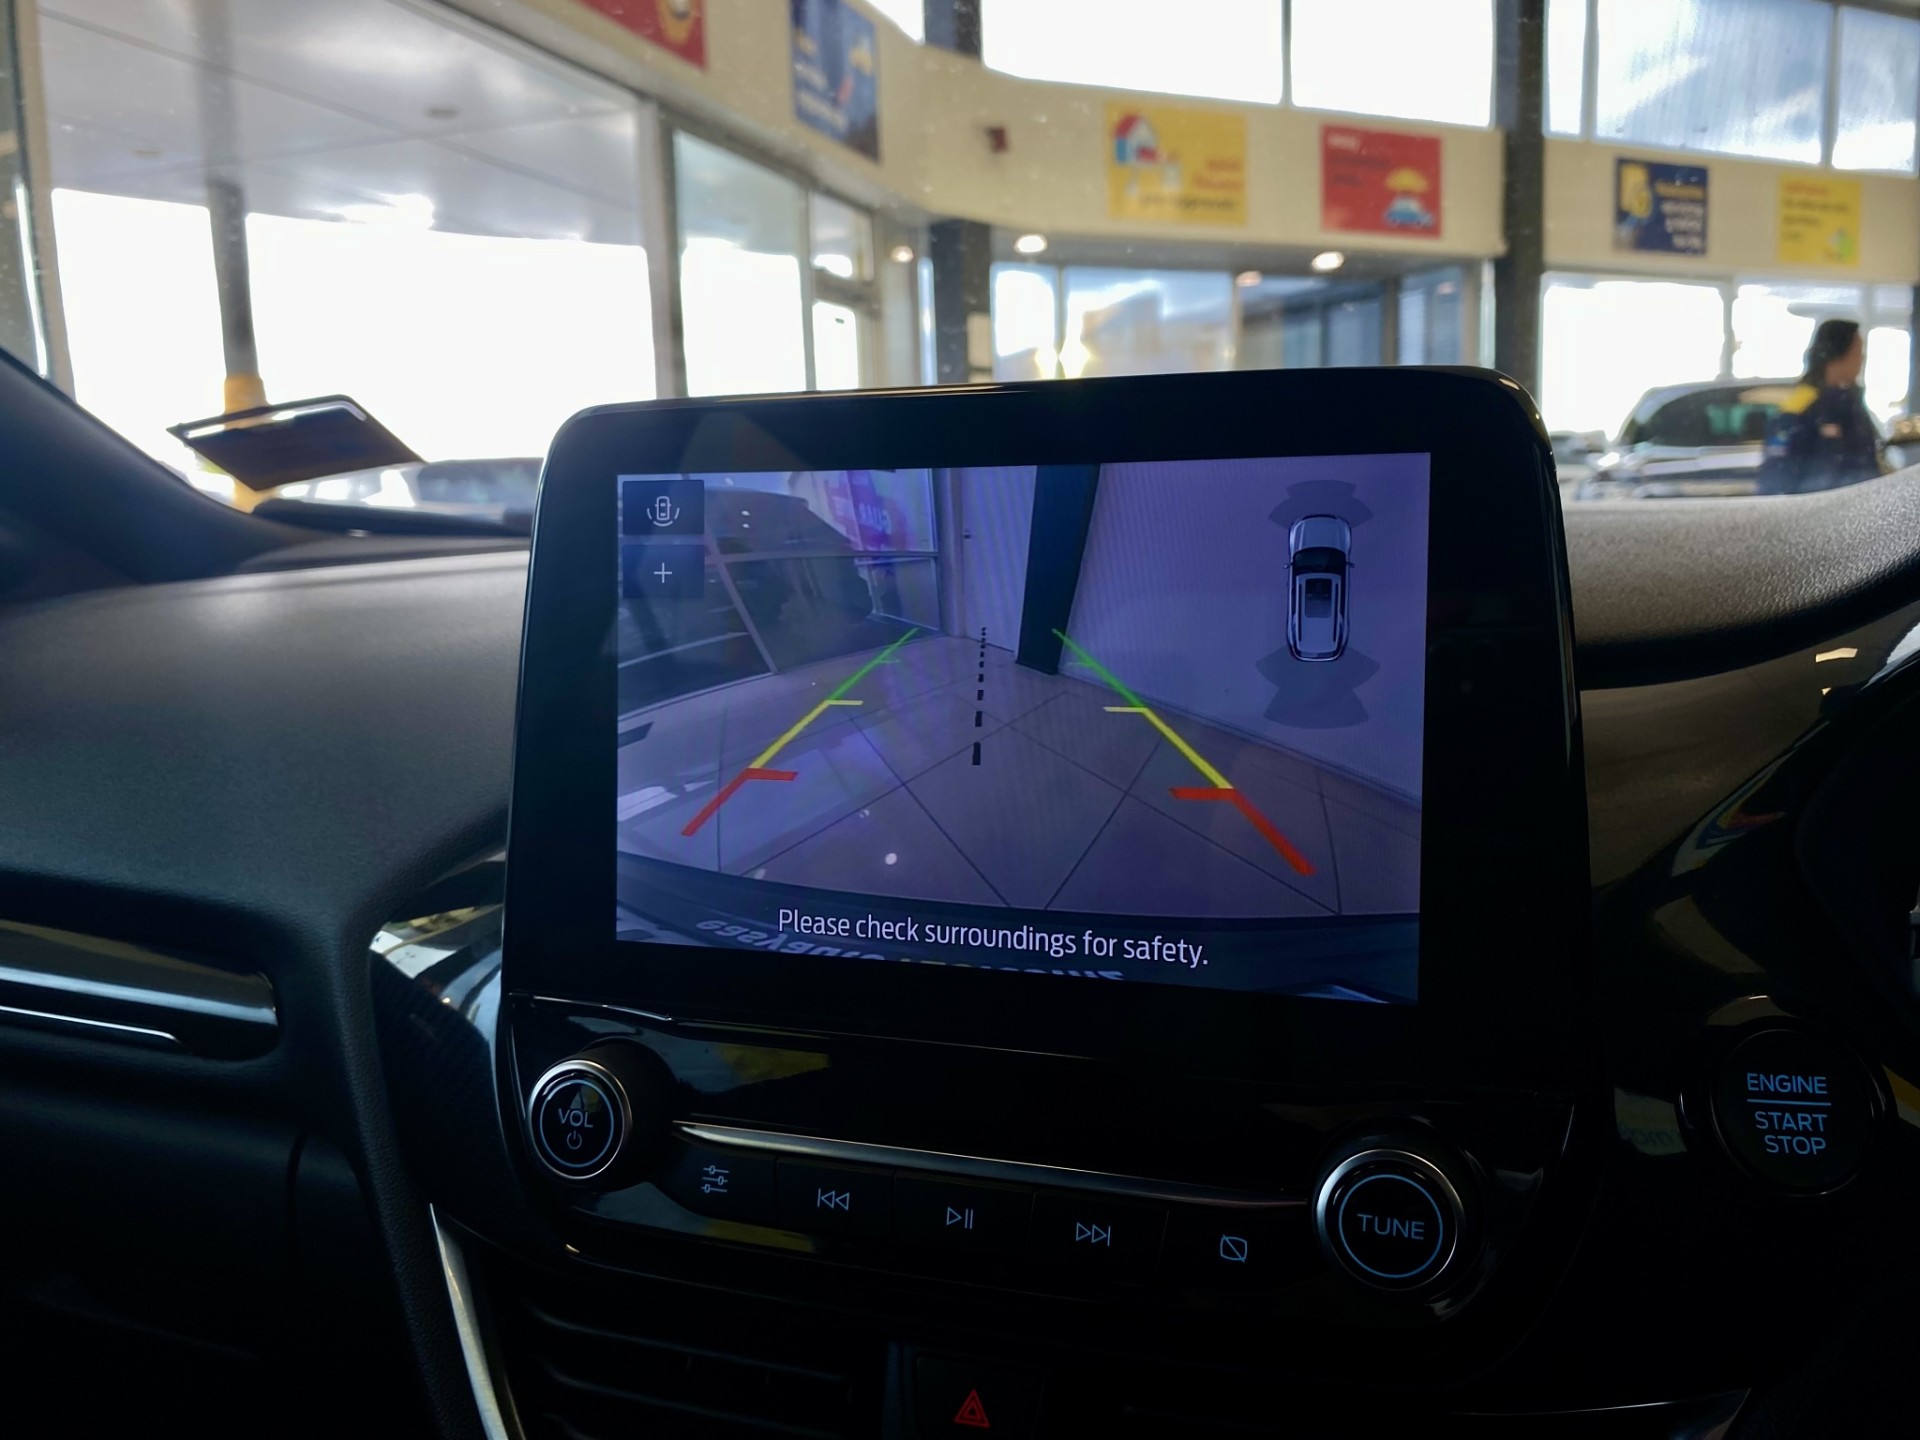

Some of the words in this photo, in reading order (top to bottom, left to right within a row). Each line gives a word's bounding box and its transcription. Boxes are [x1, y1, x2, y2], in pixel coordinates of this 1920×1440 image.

[778, 909, 850, 937] Please
[855, 913, 920, 942] check
[924, 924, 1077, 958] surroundings
[1082, 930, 1118, 957] for
[1122, 935, 1209, 969] safety.
[1746, 1072, 1828, 1095] ENGINE
[557, 1107, 595, 1129] VOL
[1754, 1110, 1828, 1133] START
[1764, 1134, 1827, 1156] STOP
[1356, 1213, 1425, 1241] TUNE
